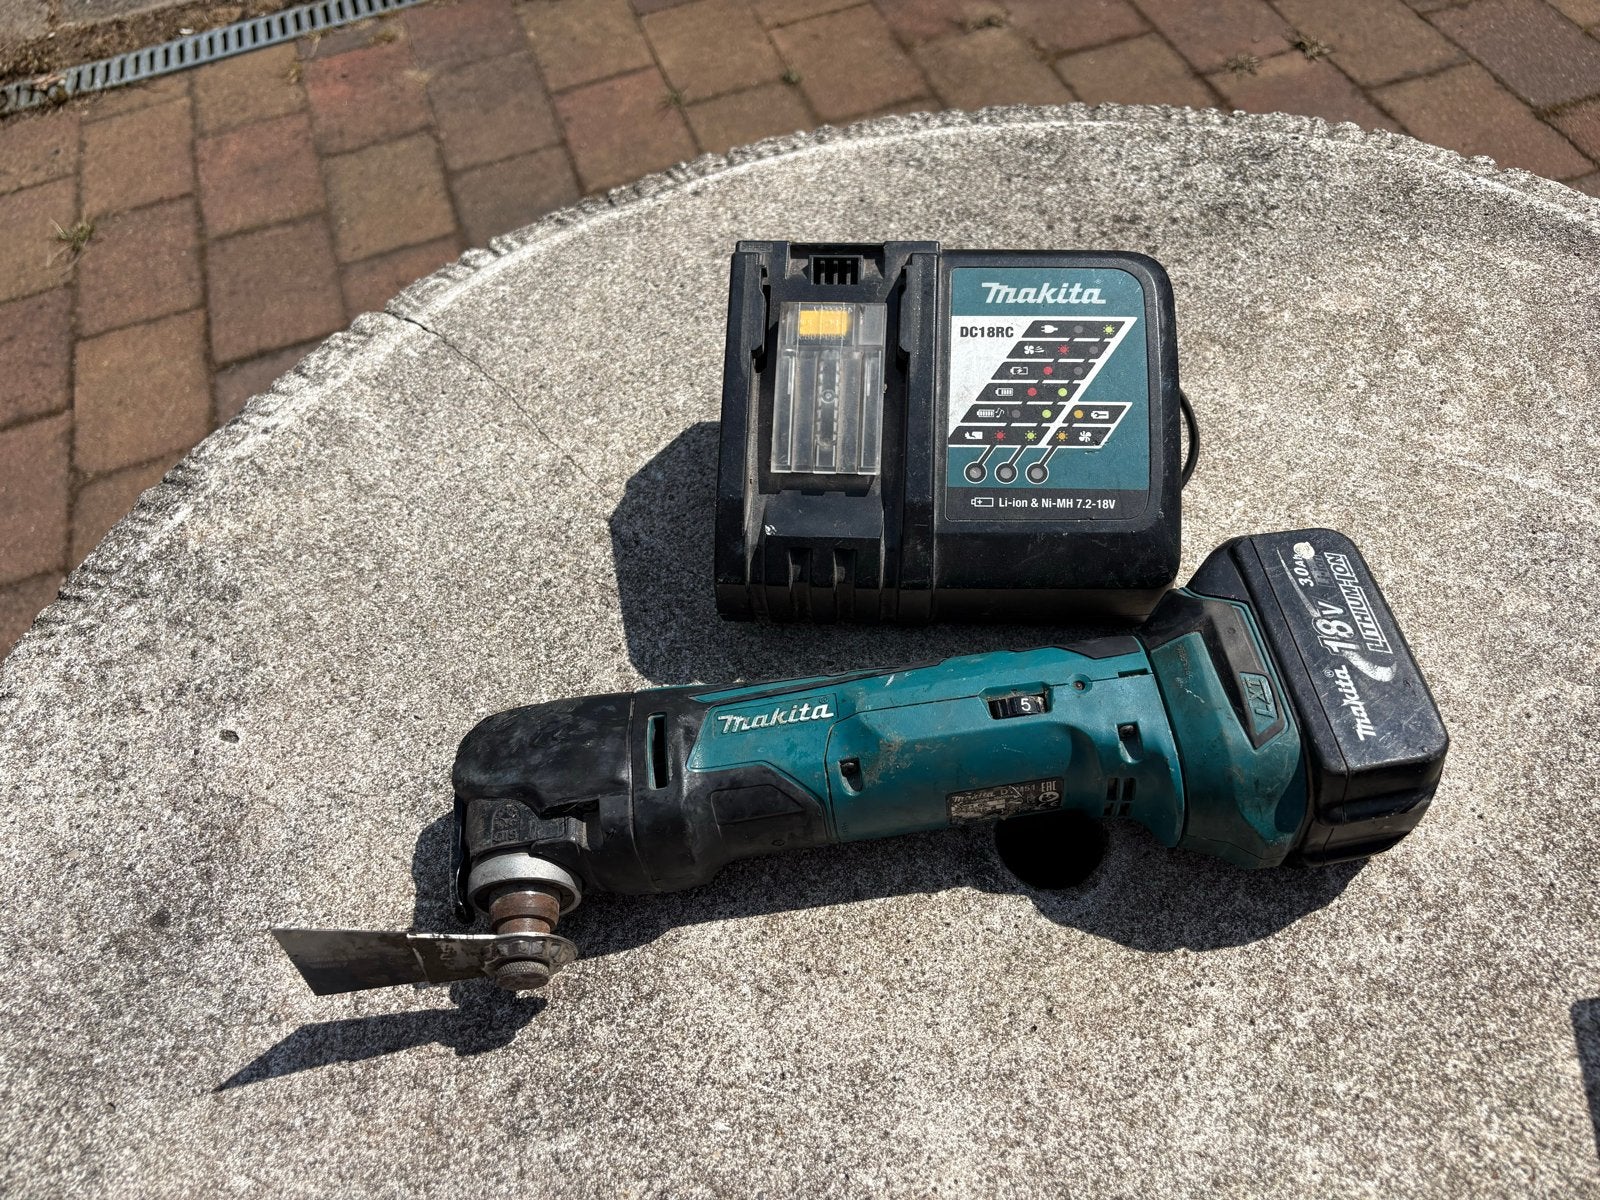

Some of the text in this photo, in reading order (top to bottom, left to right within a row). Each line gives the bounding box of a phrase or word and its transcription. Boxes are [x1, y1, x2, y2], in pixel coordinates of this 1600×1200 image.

[981, 282, 1107, 305] Makita
[959, 326, 1015, 338] DC18RC
[999, 497, 1116, 510] Li-ion & Ni-MH 7.2-18V
[1324, 552, 1393, 654] LITHIUM-ION
[1312, 601, 1358, 655] 18V
[1020, 697, 1032, 712] 5
[1243, 677, 1276, 719] LXT
[1334, 664, 1377, 741] Makita
[718, 701, 834, 735] Makita
